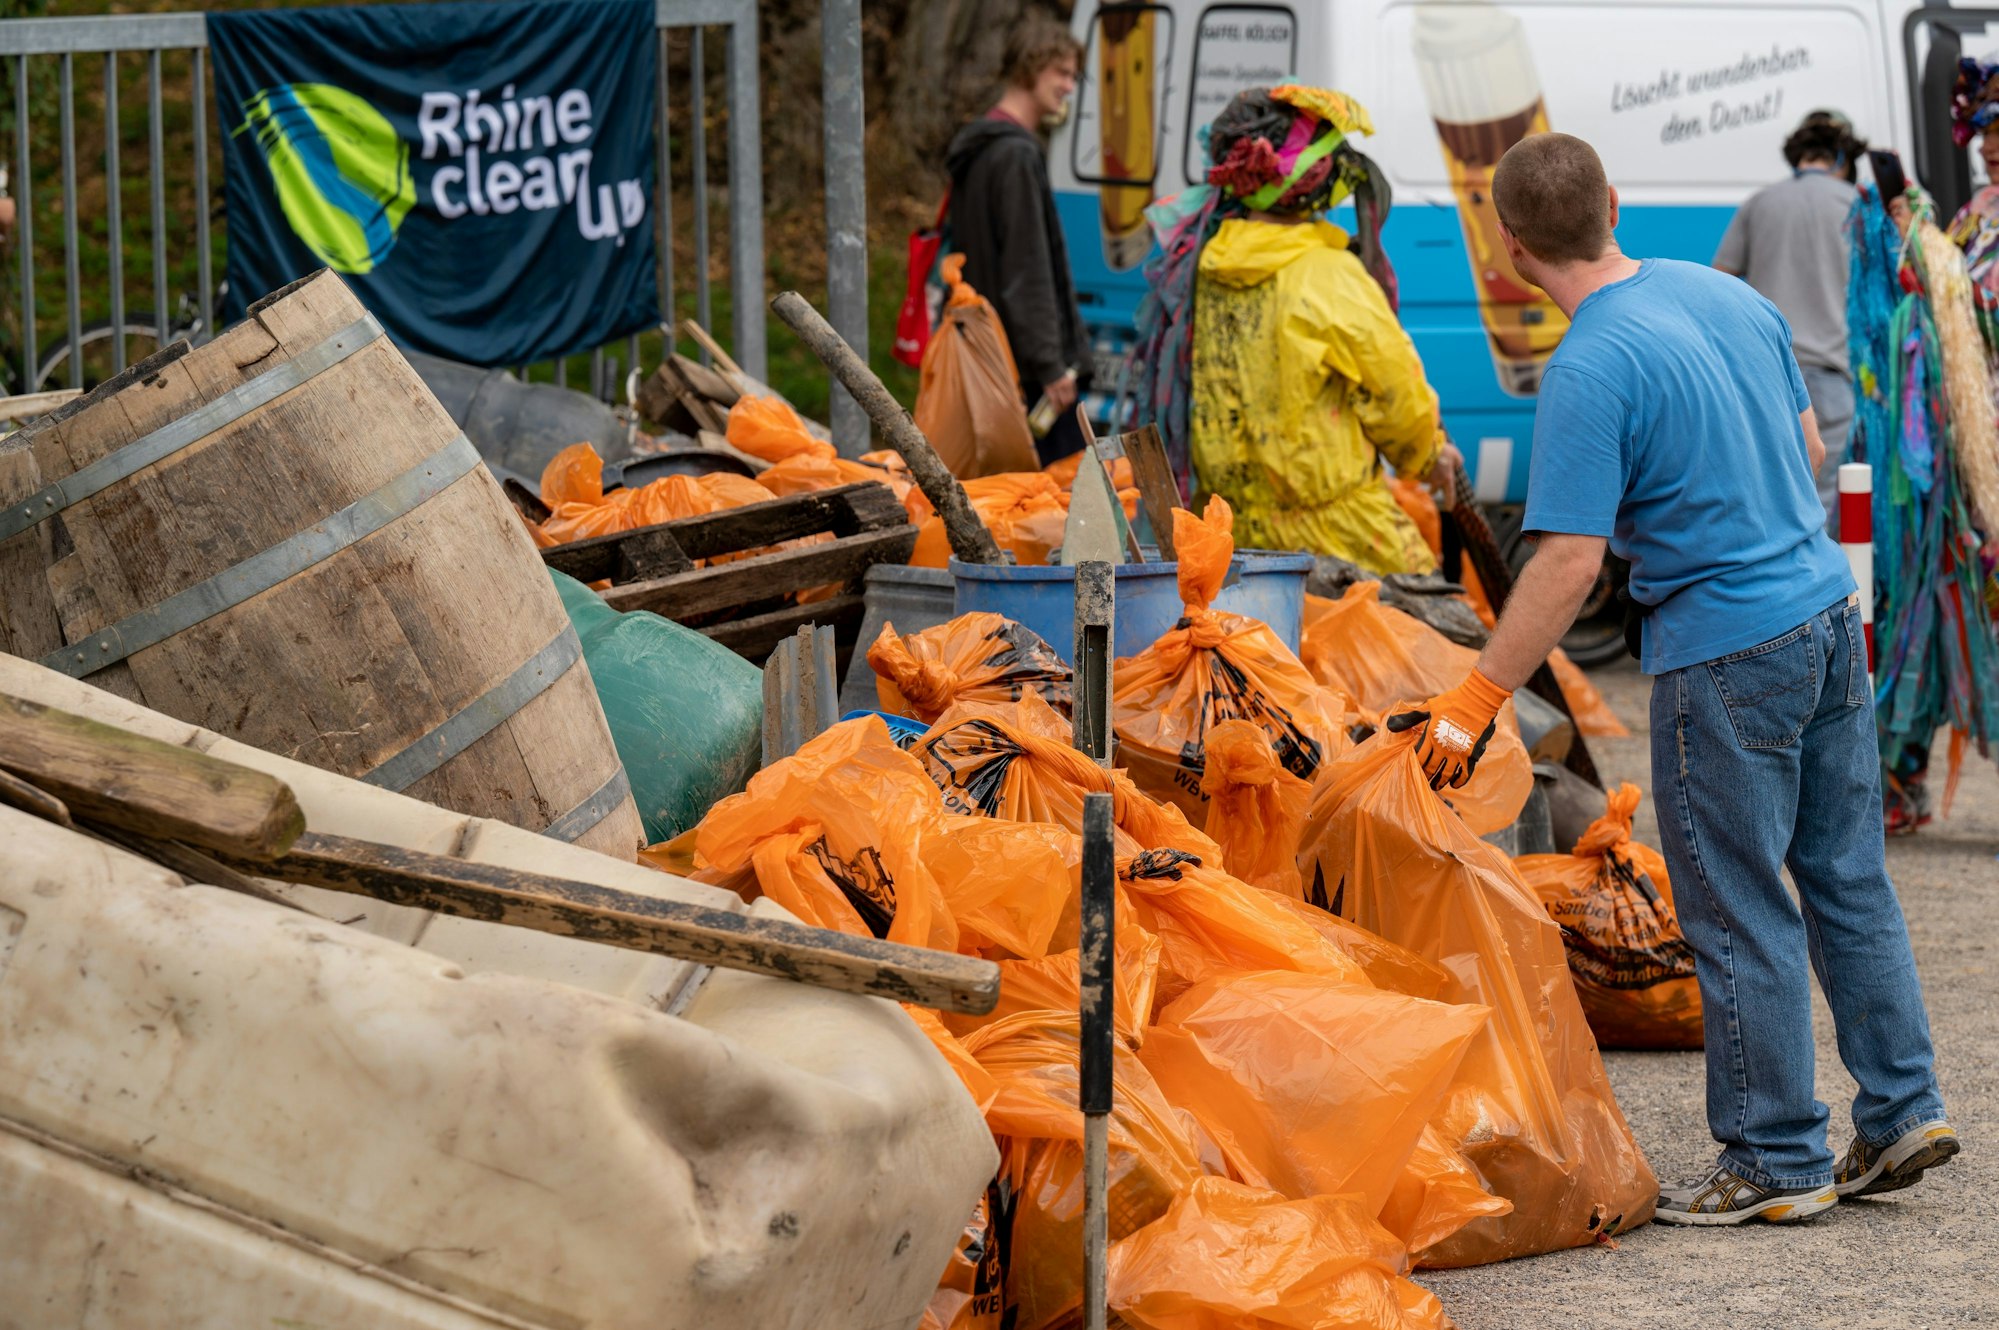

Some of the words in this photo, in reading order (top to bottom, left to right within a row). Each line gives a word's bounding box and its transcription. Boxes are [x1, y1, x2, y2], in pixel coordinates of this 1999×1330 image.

[418, 84, 593, 159] Rhine
[1708, 86, 1784, 133] Durst!
[430, 148, 594, 218] clean
